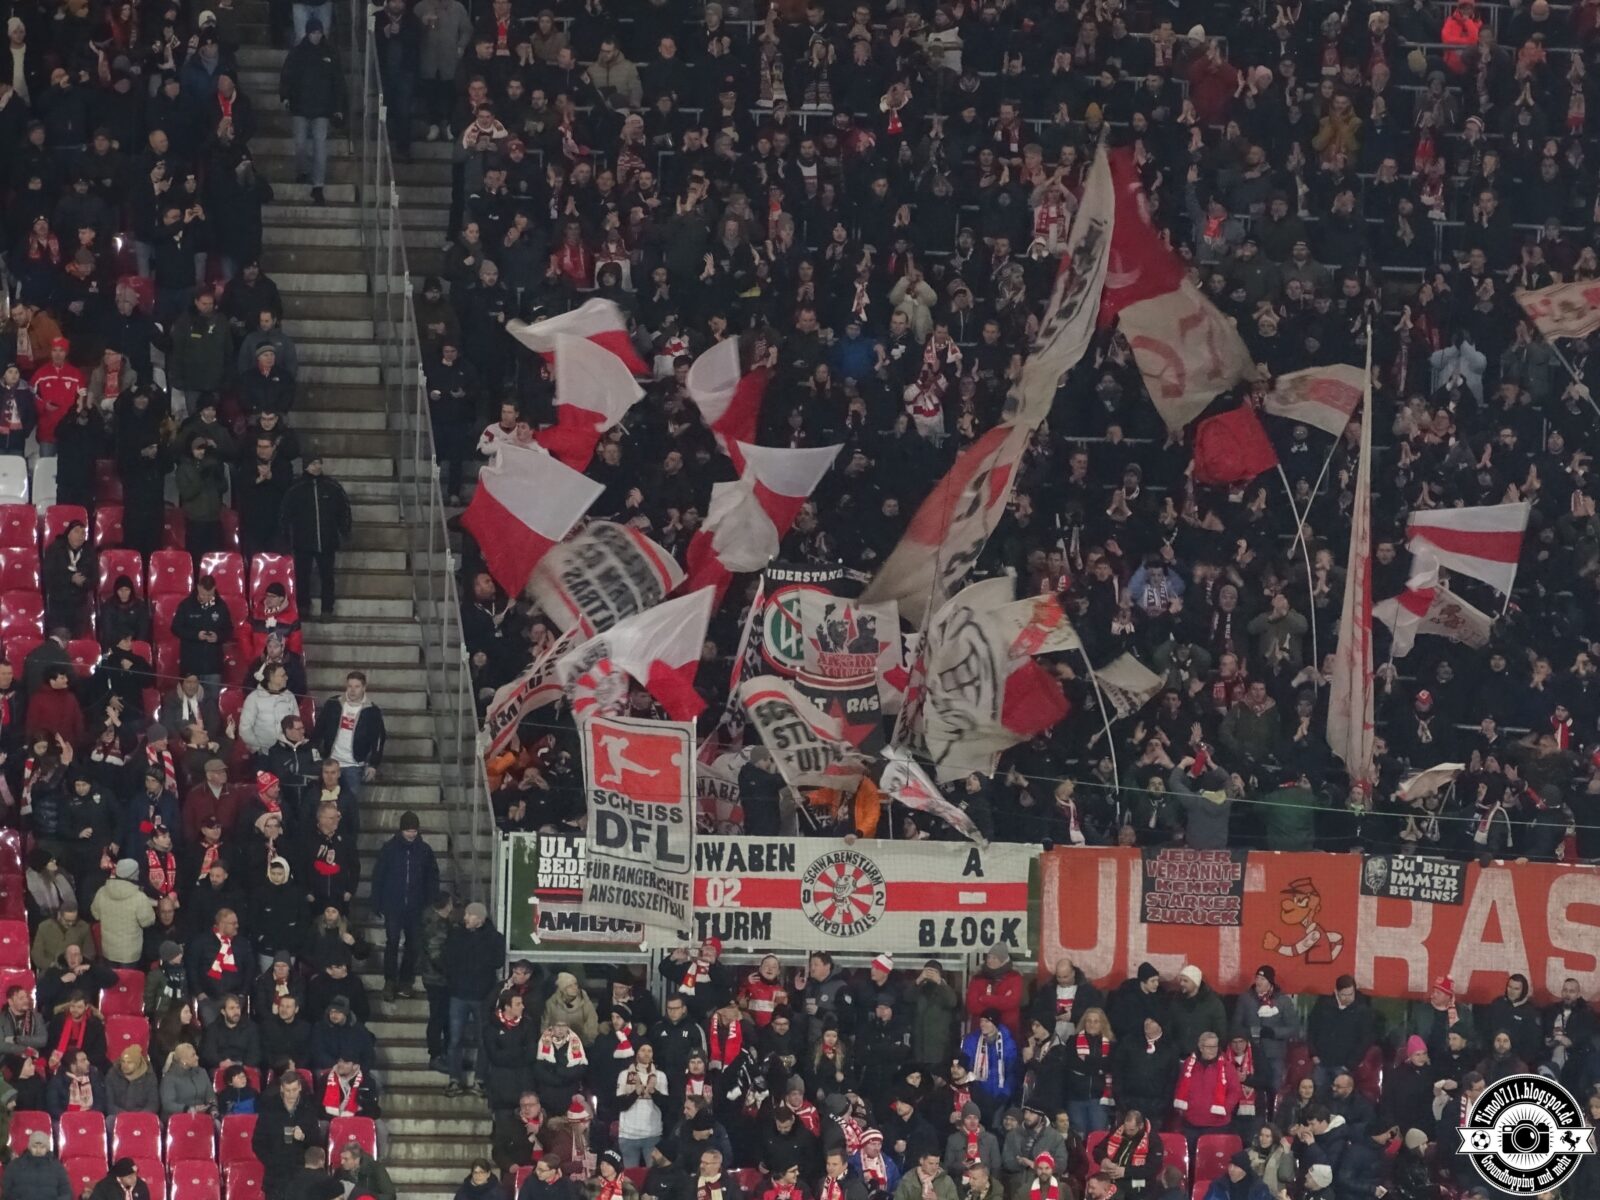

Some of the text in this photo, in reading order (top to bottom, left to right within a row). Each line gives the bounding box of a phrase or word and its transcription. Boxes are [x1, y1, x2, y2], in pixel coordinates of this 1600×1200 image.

[593, 789, 683, 824] SCHEISS
[596, 810, 685, 864] DFL
[962, 847, 984, 877] A
[1157, 848, 1232, 863] JEDER
[586, 859, 611, 880] FÜR
[804, 851, 883, 886] SCHWABENSTURM
[1146, 859, 1242, 880] VERBANNTE
[1391, 858, 1460, 877] DU BIST
[537, 873, 583, 889] WIDE
[706, 878, 742, 907] 02
[1155, 878, 1234, 895] KEHRT
[1390, 871, 1458, 891] IMMER
[1389, 885, 1459, 903] BEI UNS!
[678, 911, 772, 941] TURM
[809, 912, 877, 937] STUTTGART
[919, 916, 1021, 947] BLOCK
